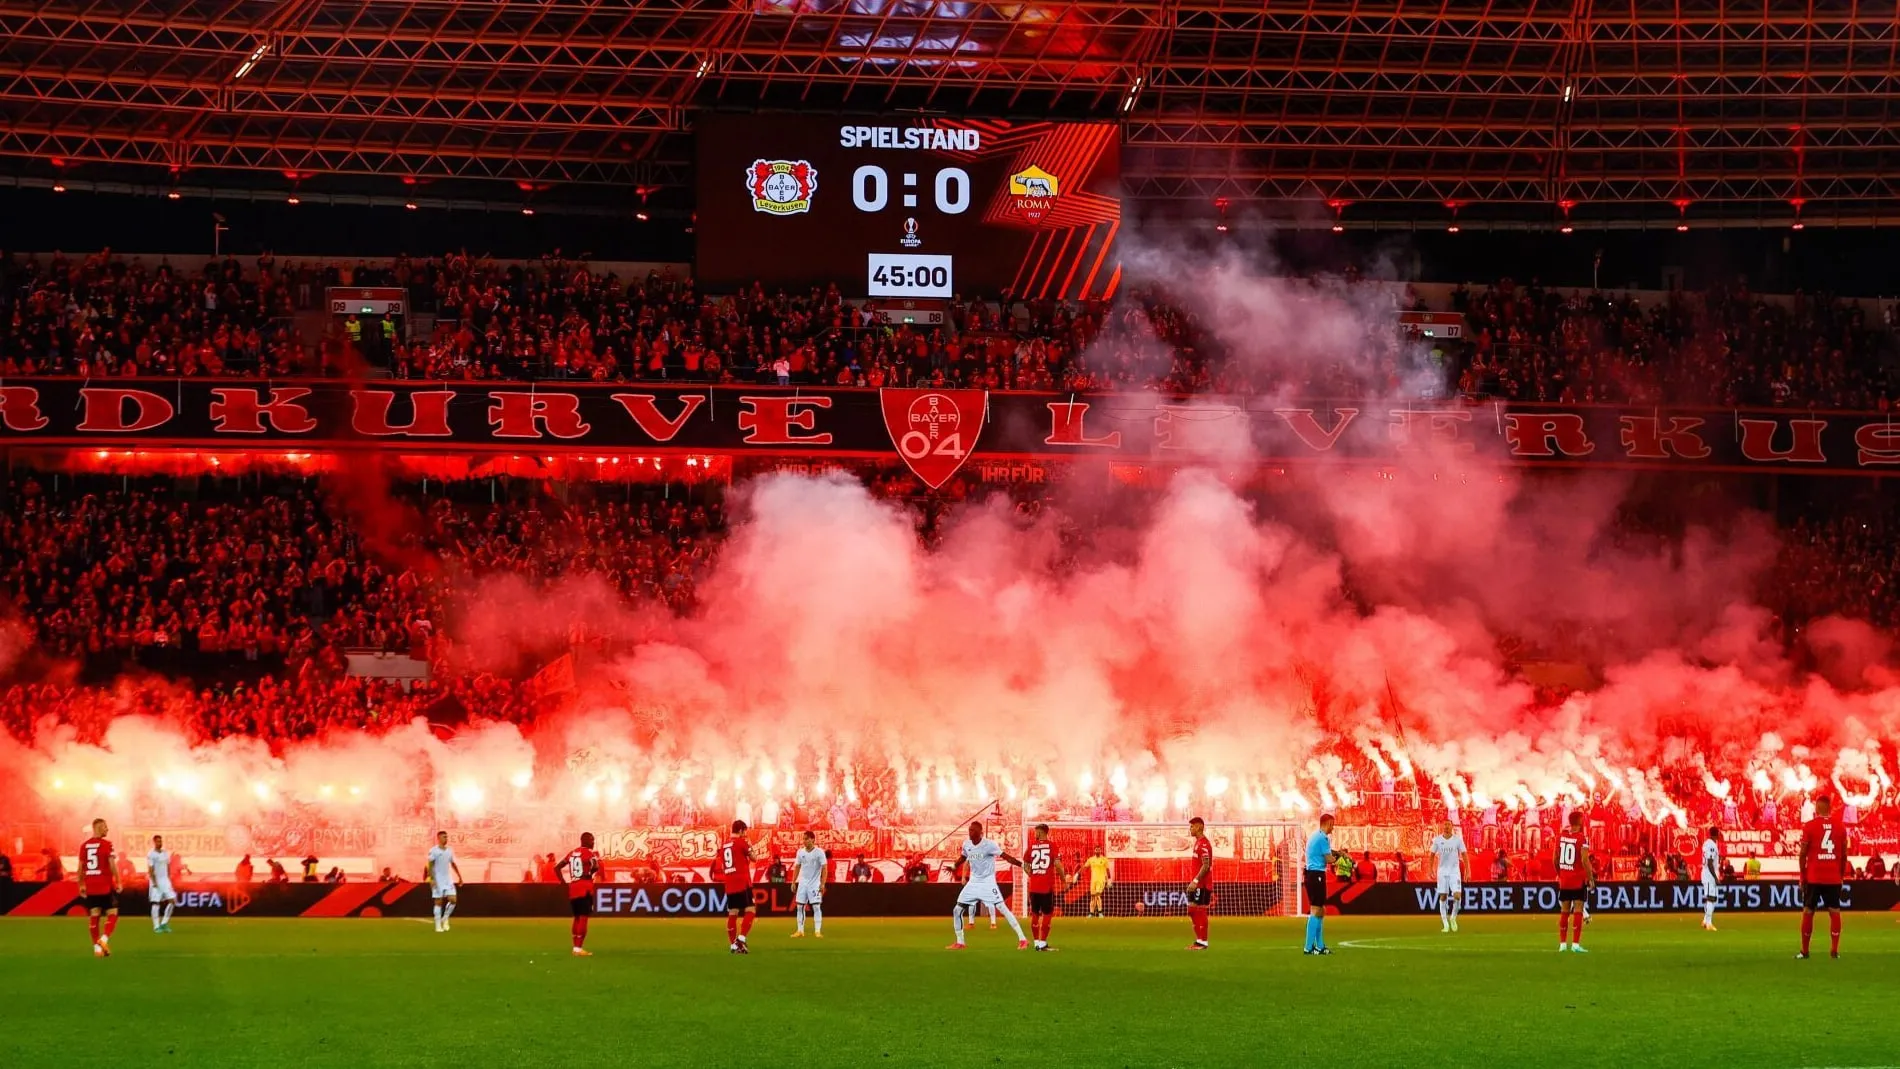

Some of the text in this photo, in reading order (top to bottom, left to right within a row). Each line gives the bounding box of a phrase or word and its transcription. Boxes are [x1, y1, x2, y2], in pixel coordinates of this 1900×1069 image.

[840, 125, 980, 151] SPIELSTAND
[760, 201, 804, 211] Leverkusen
[1017, 199, 1051, 209] ROMA
[872, 266, 948, 288] 45:00
[911, 413, 958, 423] BAYER
[929, 397, 939, 440] BAYER
[900, 430, 966, 460] 04
[123, 833, 225, 853] CRSSFIRE
[1720, 829, 1772, 842] YOUNG
[1821, 830, 1835, 854] 4
[86, 848, 98, 870] 5
[724, 847, 733, 868] 9
[1031, 849, 1051, 870] 25
[1559, 842, 1576, 865] 10
[569, 856, 583, 878] 19
[175, 891, 222, 908] UEFA
[595, 887, 728, 912] EFA.COM
[1144, 891, 1189, 907] UEFA
[1522, 885, 1664, 910] FOBALL
